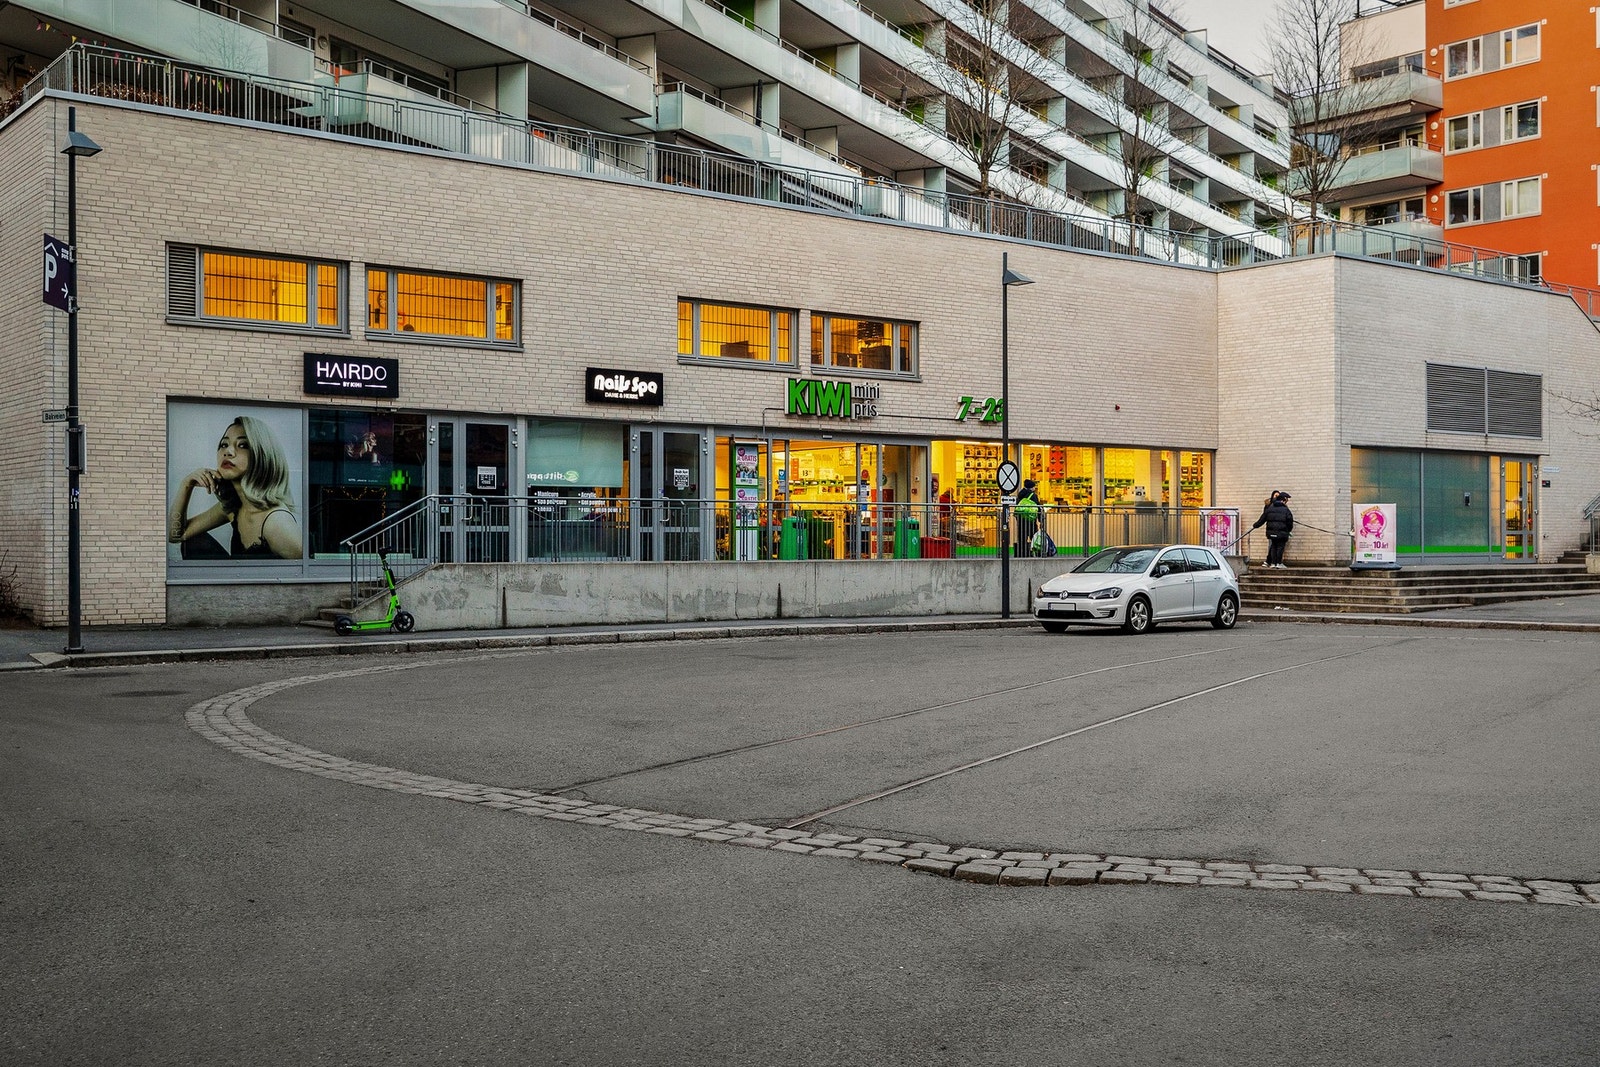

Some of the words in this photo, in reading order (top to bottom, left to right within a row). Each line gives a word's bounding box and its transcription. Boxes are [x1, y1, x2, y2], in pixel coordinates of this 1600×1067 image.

[45, 253, 57, 292] P
[317, 361, 387, 380] HAIRDO
[594, 374, 630, 392] Nails
[631, 377, 658, 397] Spa
[854, 382, 880, 399] mini
[784, 378, 851, 417] KIWI
[854, 400, 878, 419] pris
